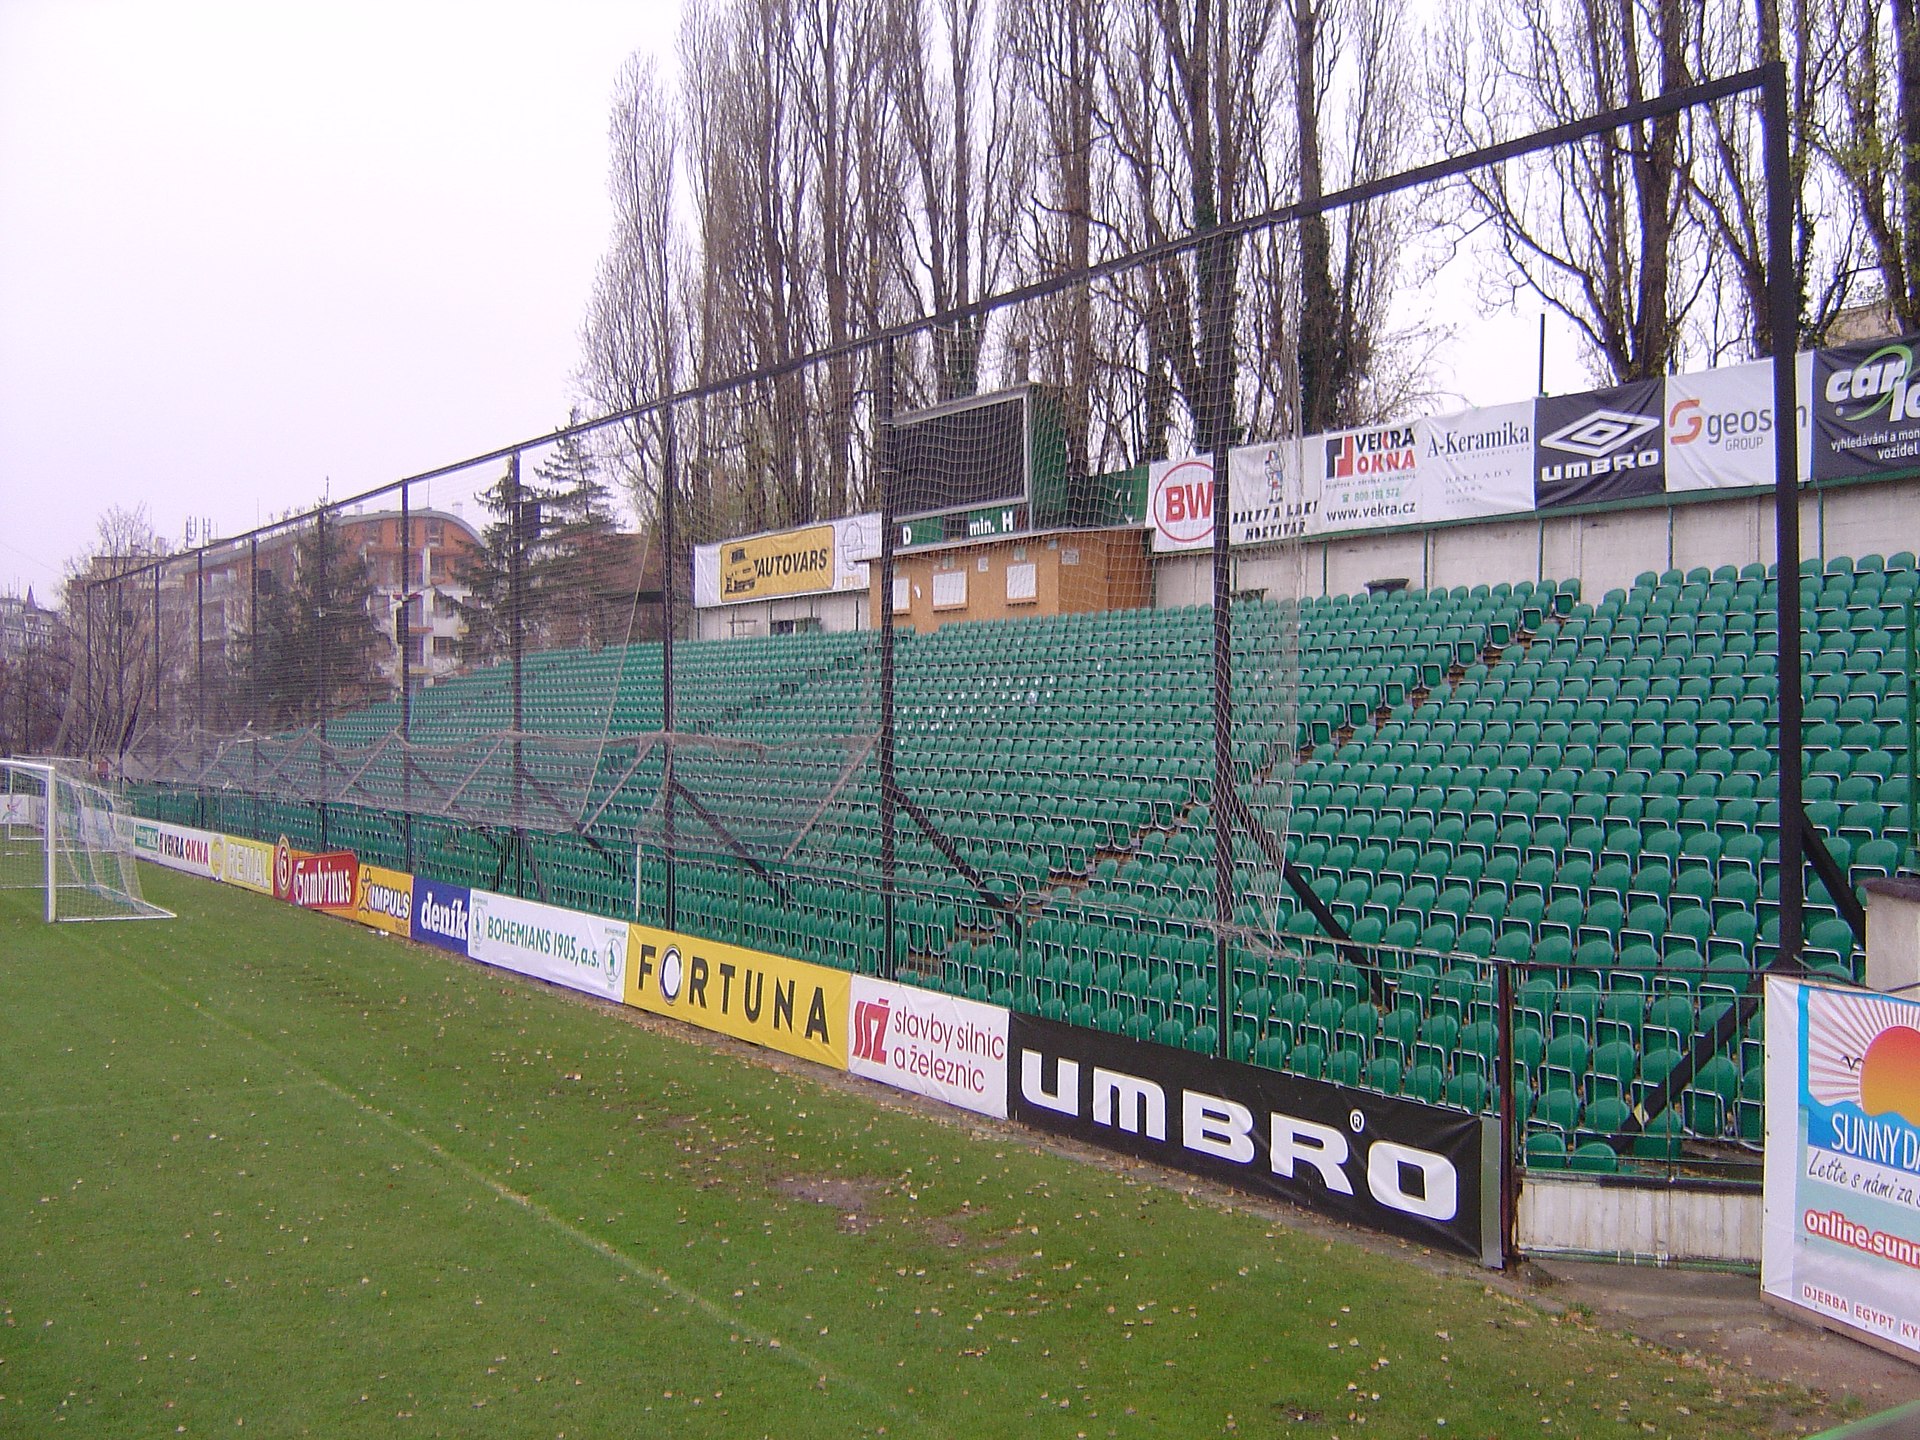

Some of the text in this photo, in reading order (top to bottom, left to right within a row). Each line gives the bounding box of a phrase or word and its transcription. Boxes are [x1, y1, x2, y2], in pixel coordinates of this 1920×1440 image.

[1825, 360, 1906, 403] car
[1355, 428, 1416, 453] VEKRA
[1427, 421, 1530, 458] A-Keramika
[1725, 436, 1764, 451] GROUP
[1831, 430, 1888, 453] vyhledávání
[1889, 434, 1897, 442] a
[1877, 441, 1918, 460] vozidel
[1356, 449, 1416, 475] OKNA
[903, 525, 912, 546] D
[1002, 511, 1014, 532] H
[1326, 502, 1416, 522] www.vekra.cz
[756, 547, 828, 579] AUTOVARS
[371, 883, 411, 920] IMPULS
[421, 891, 469, 941] deník
[487, 915, 551, 954] BOHEMIANS
[636, 943, 830, 1045] FORTUNA
[894, 1005, 1005, 1061] stavby silnic
[893, 1044, 985, 1094] a železnic
[1831, 1112, 1901, 1166] SUNNY
[1863, 1172, 1897, 1199] námi
[1896, 1186, 1914, 1205] za
[1803, 1285, 1920, 1340] DJERBA EGYPT KY
